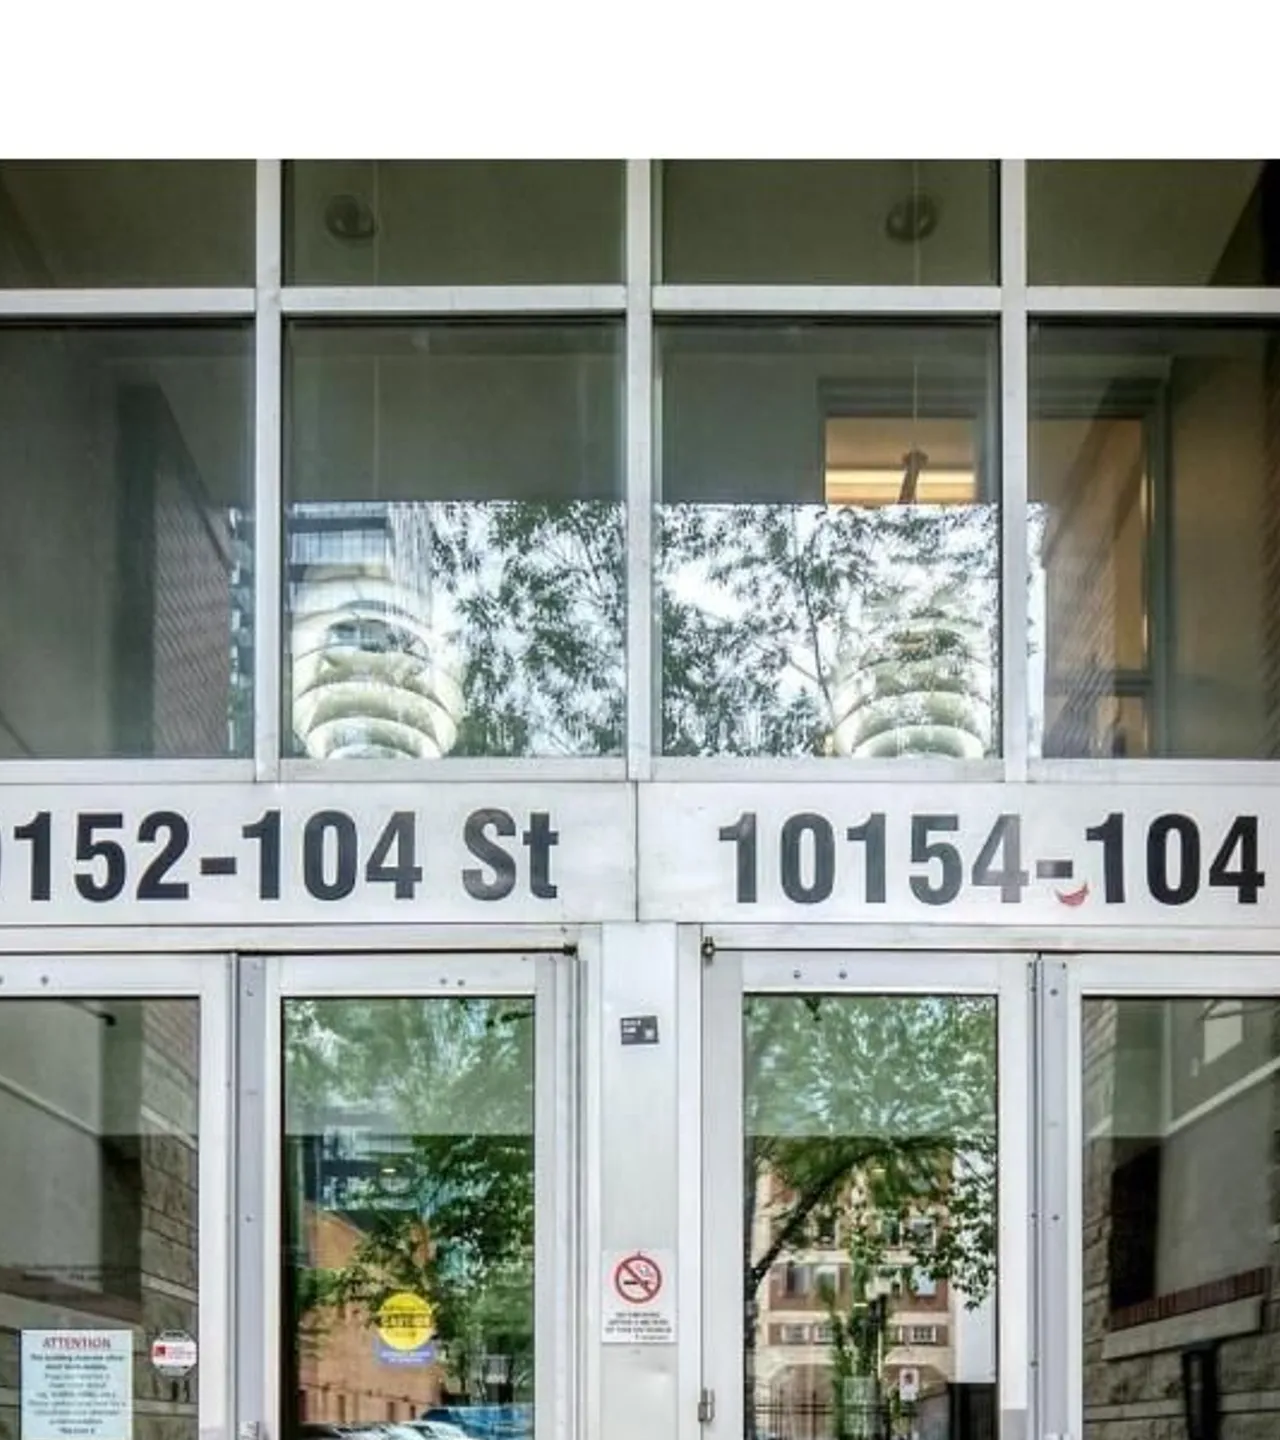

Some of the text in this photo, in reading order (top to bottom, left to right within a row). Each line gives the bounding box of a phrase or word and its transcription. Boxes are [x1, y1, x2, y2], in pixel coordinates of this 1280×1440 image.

[461, 808, 559, 901] St
[718, 811, 1265, 907] 10154-104
[42, 1336, 111, 1349] ATTENTION
